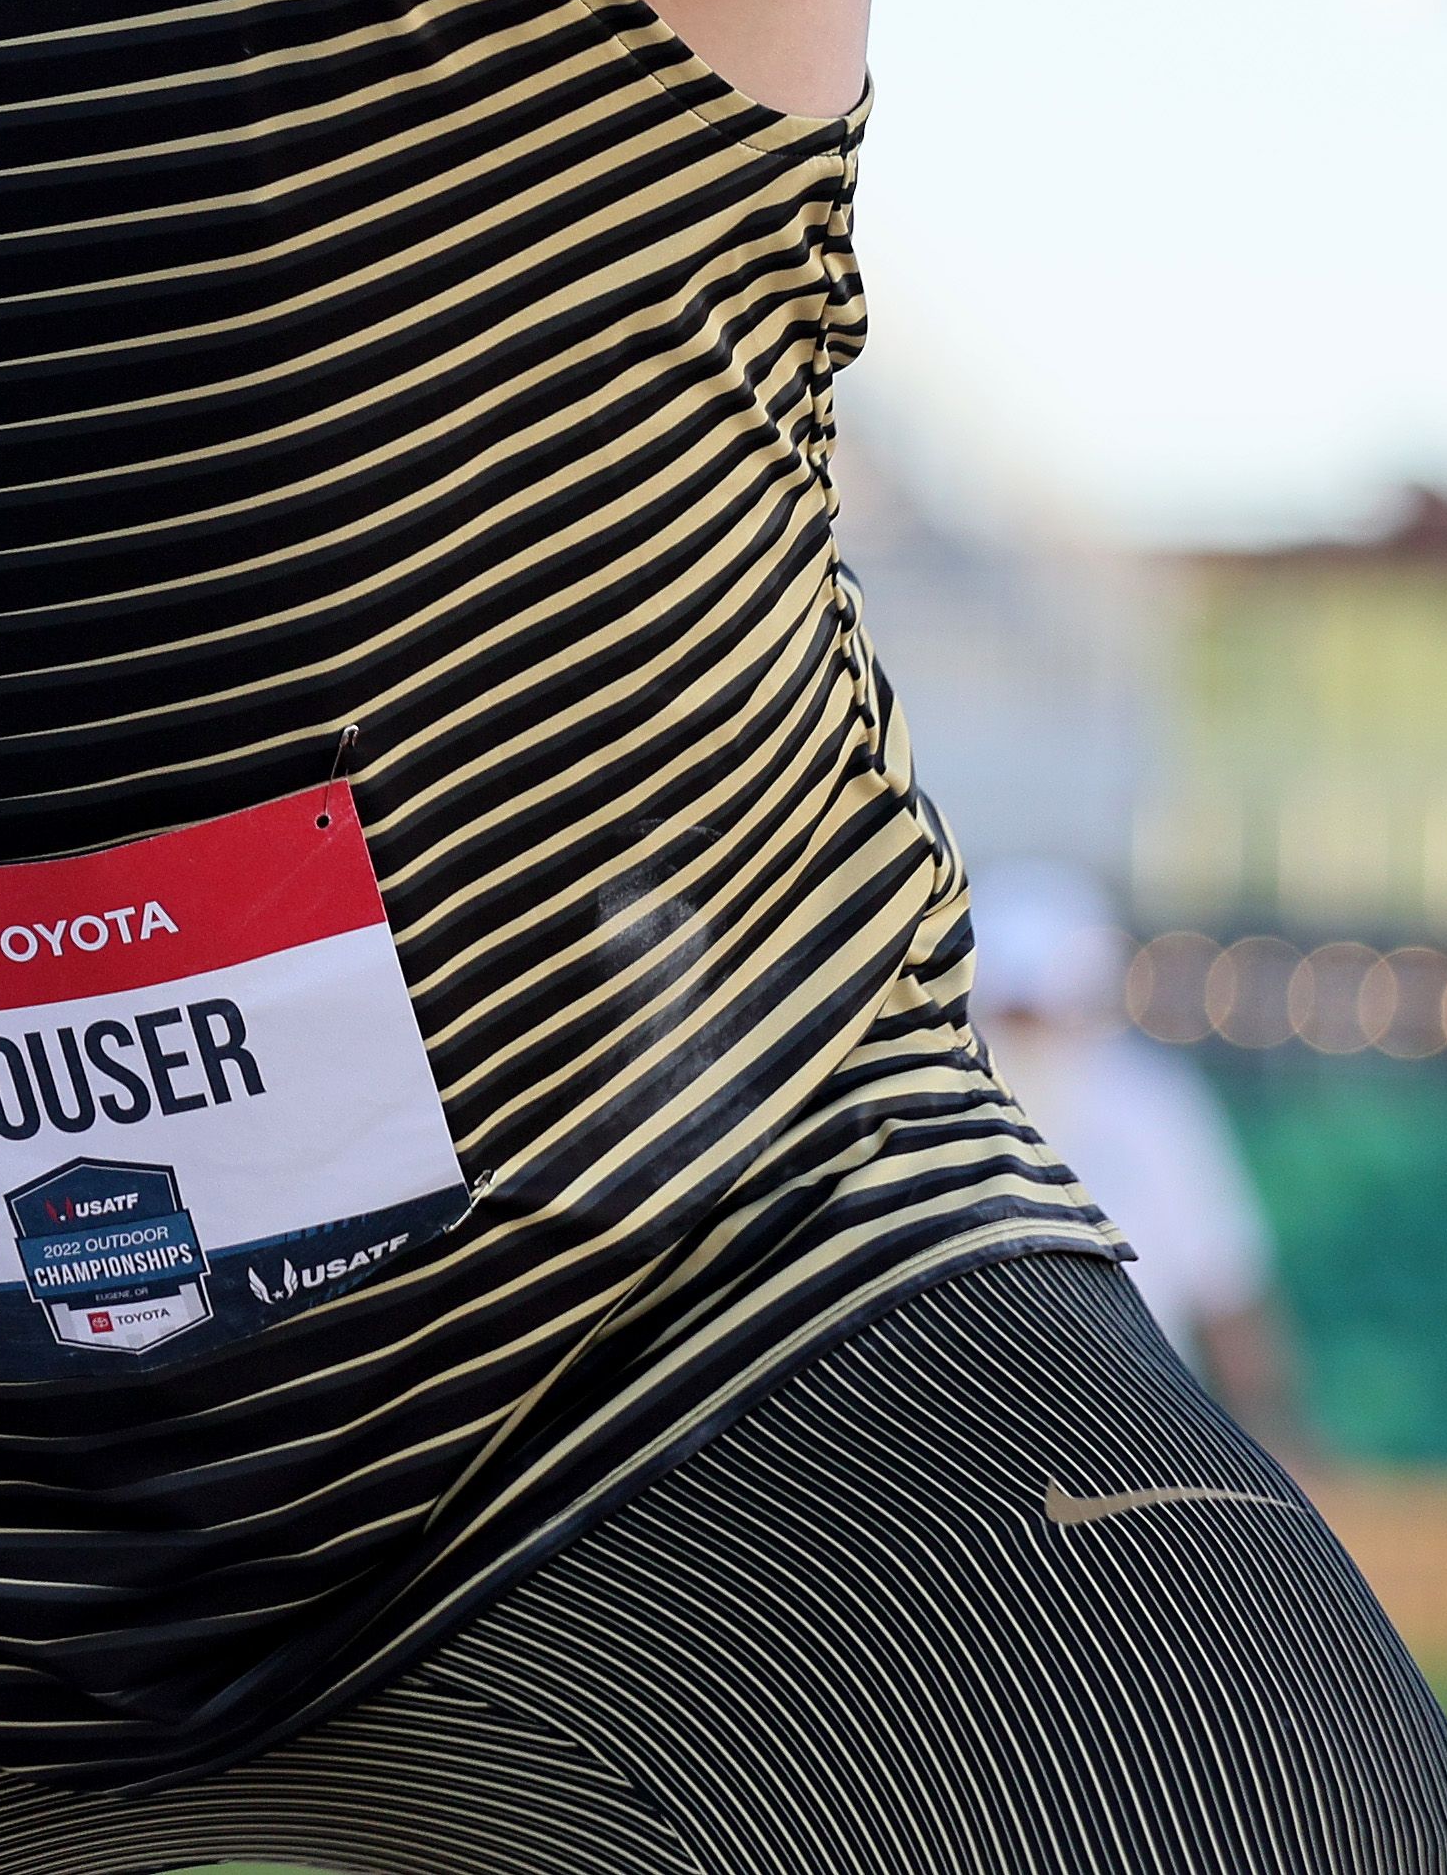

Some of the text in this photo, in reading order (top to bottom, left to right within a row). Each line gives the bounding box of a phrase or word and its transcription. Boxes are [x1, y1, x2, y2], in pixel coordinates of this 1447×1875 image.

[75, 1192, 139, 1218] USATF
[43, 1226, 169, 1259] 2022 OUTDOOR
[33, 1243, 194, 1288] CHAMPIONSHIPS
[301, 1232, 410, 1289] USATF
[95, 1287, 149, 1302] EUGENE, OR
[115, 1307, 171, 1326] TOYOTA
